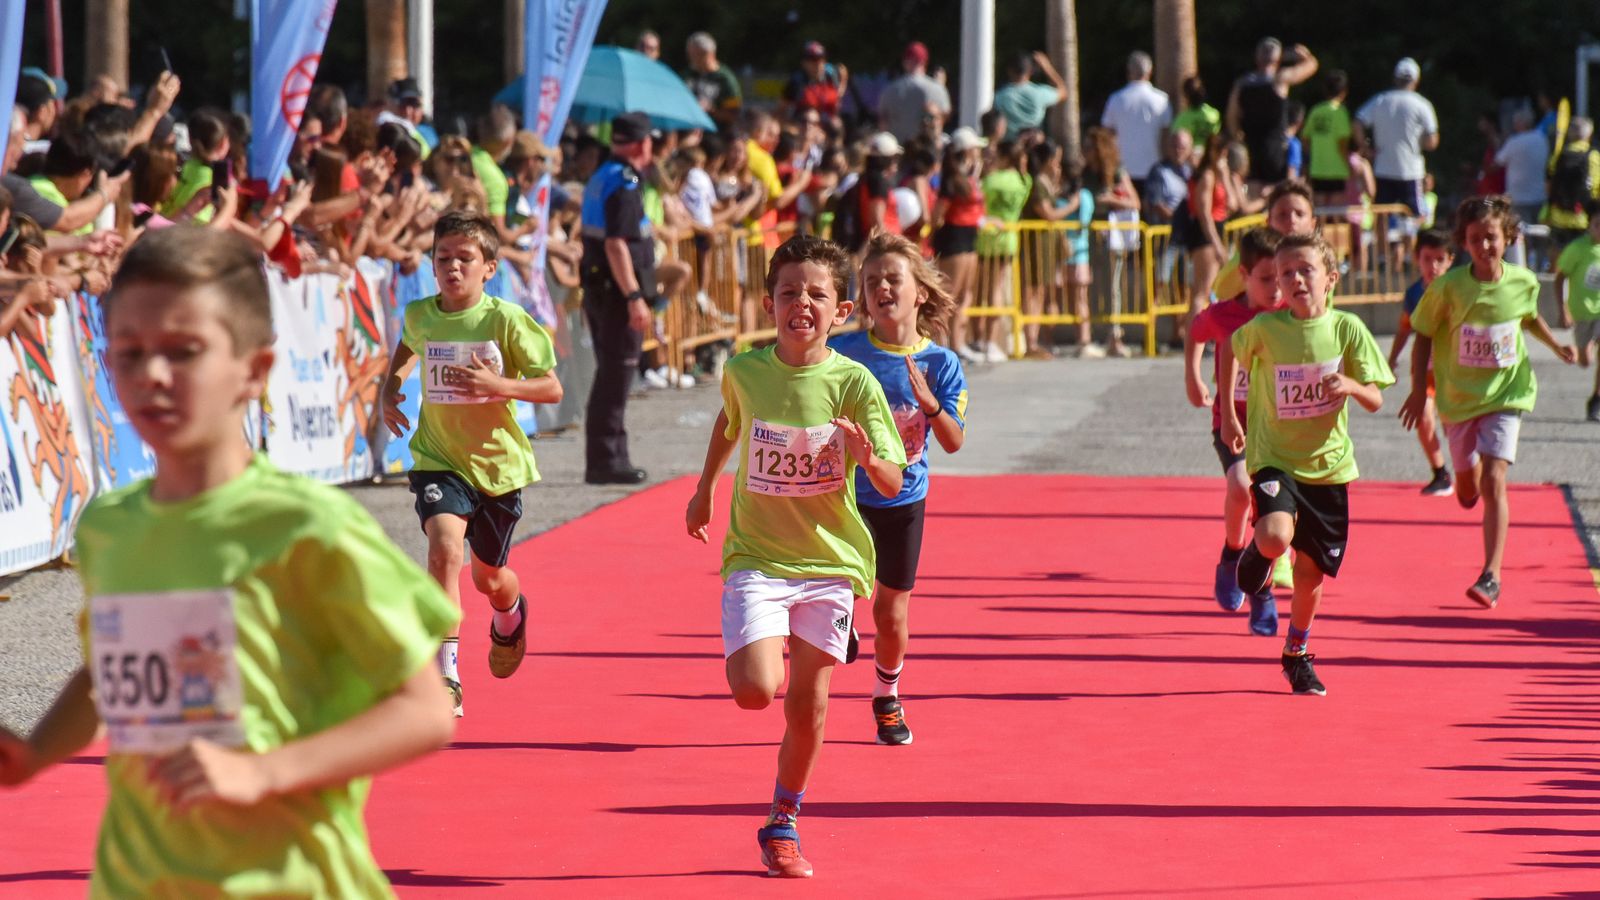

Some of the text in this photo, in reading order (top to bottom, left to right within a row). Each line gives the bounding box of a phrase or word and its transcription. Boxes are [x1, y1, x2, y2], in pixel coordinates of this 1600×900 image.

[428, 347, 441, 357] XXI
[754, 426, 769, 440] XXI
[755, 448, 813, 478] 1233
[102, 653, 169, 707] 550
